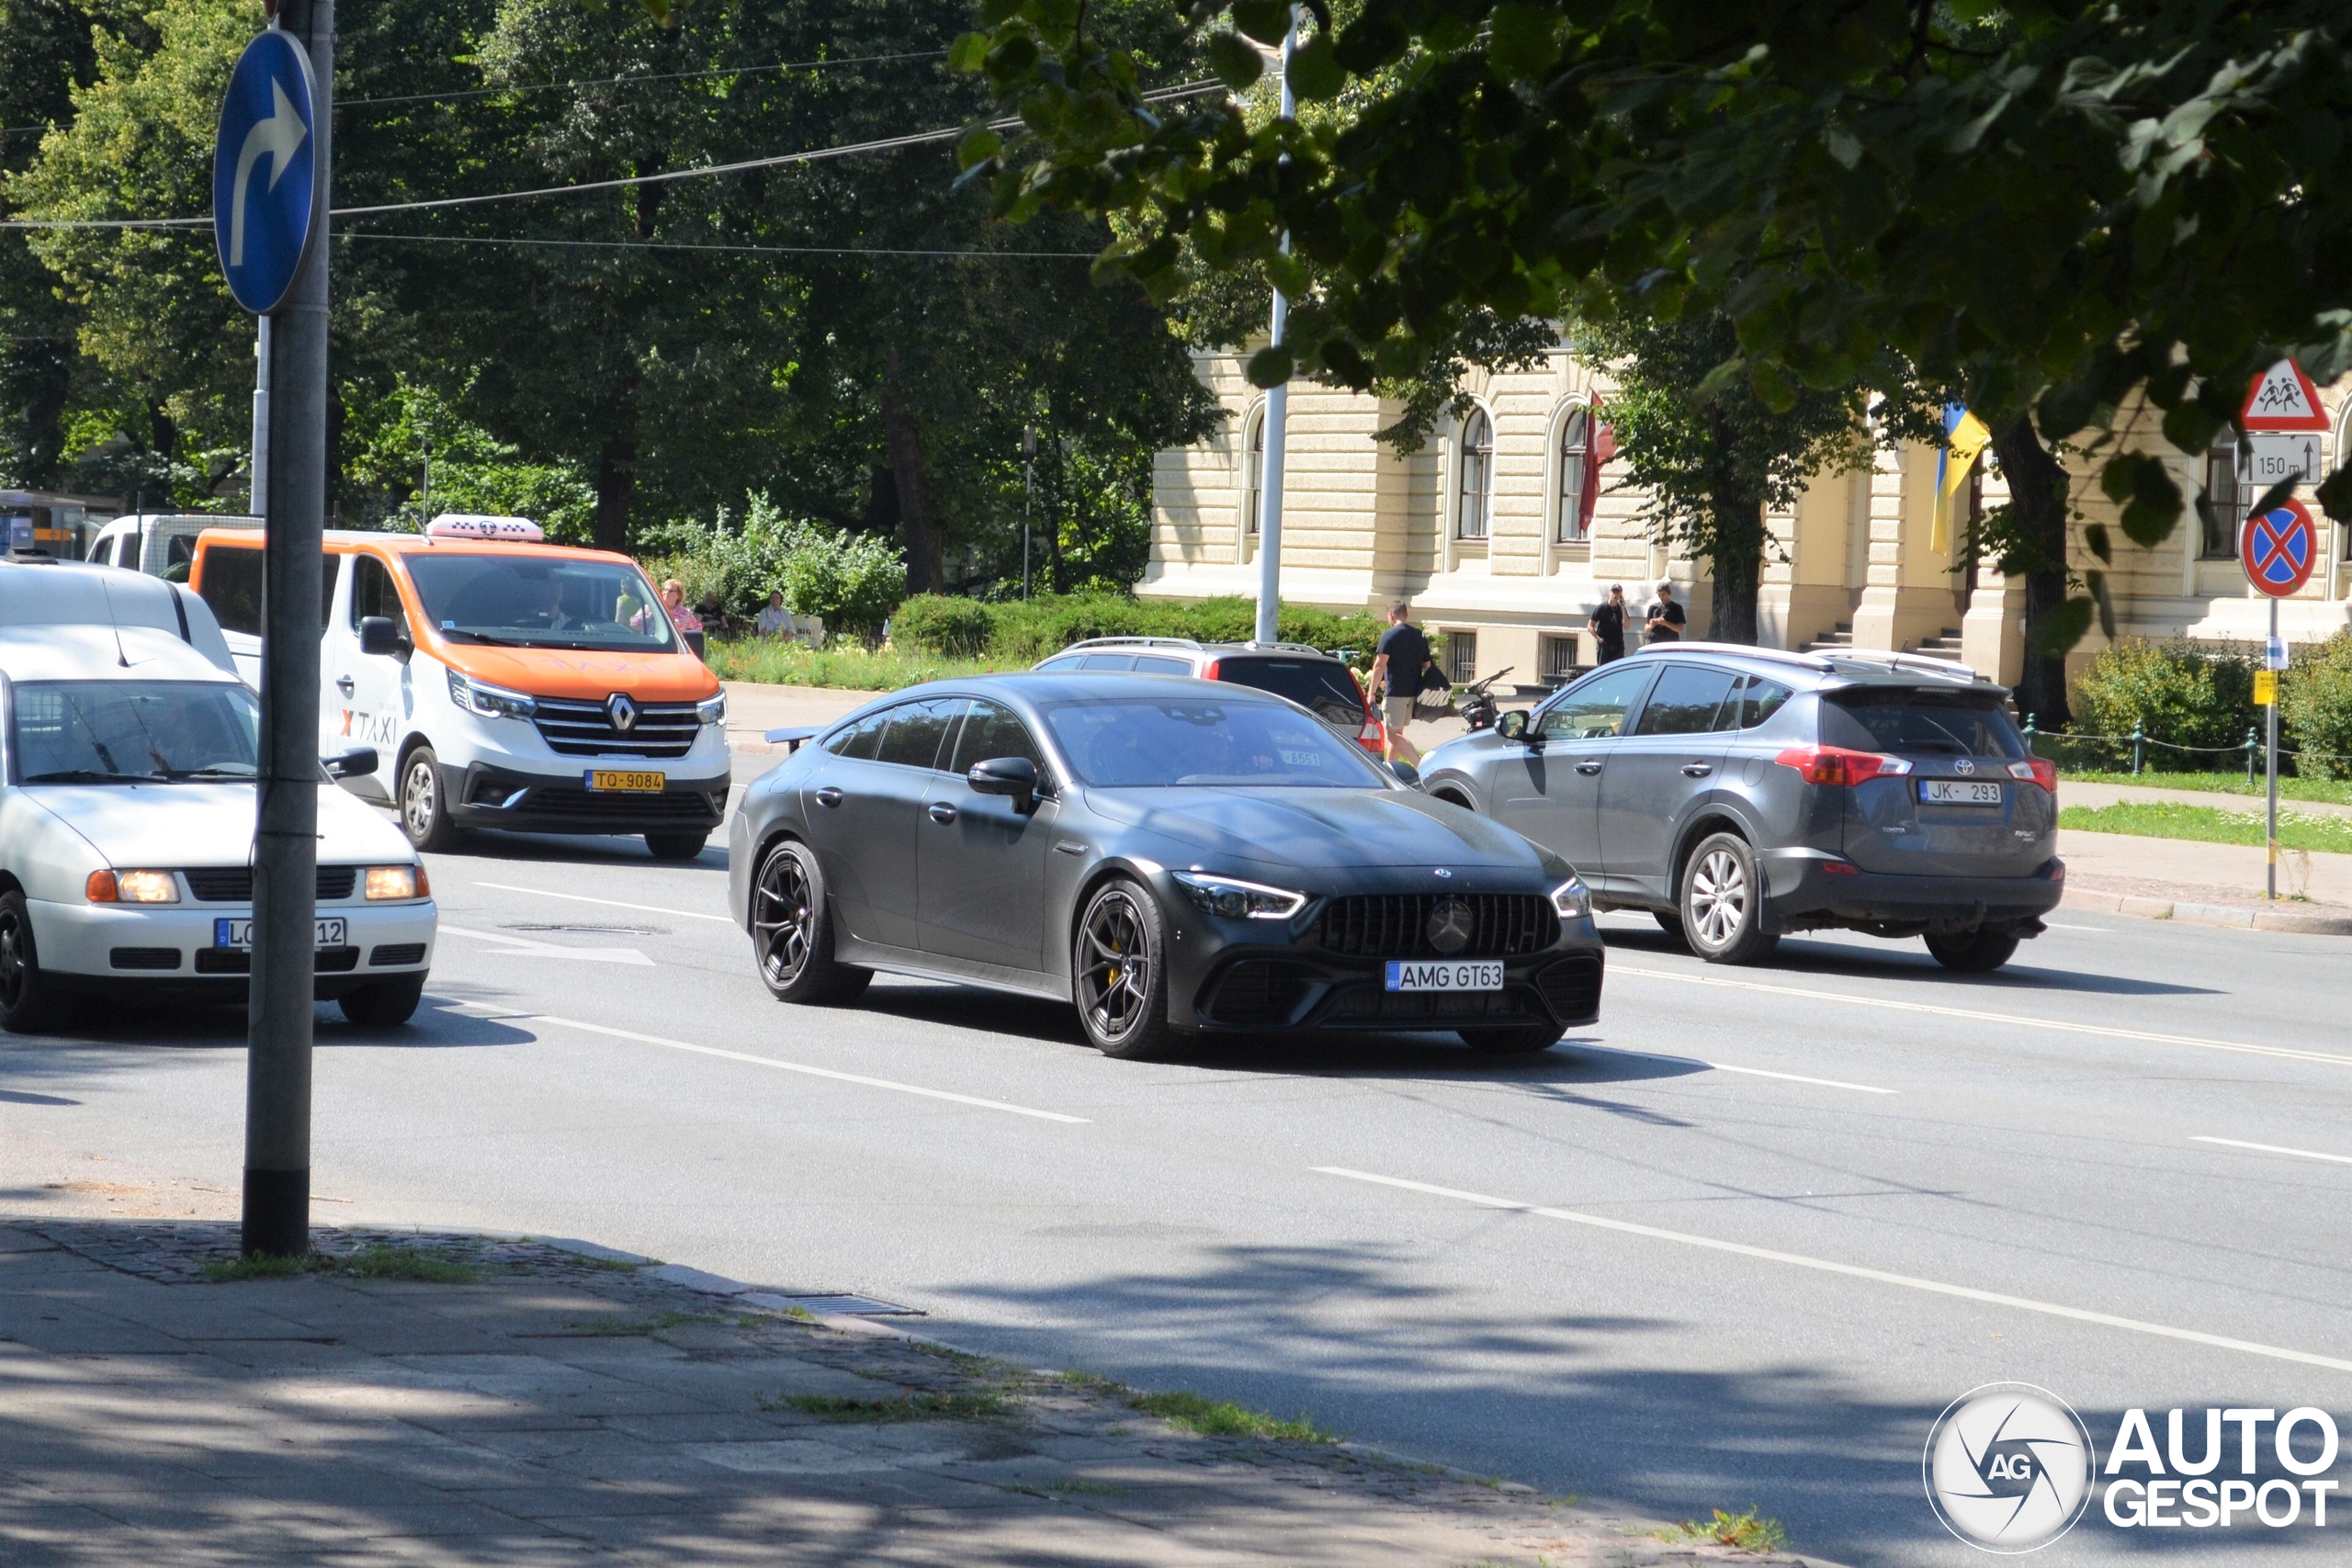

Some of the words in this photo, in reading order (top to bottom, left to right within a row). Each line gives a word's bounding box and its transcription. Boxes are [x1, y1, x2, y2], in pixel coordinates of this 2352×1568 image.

[2259, 457, 2285, 475] 150
[2289, 464, 2301, 475] m
[358, 711, 397, 746] TAXI
[596, 773, 661, 788] TQ-9084
[1972, 784, 1998, 801] 293
[1387, 979, 1399, 987] EST
[1400, 965, 1450, 987] AMG
[1456, 964, 1501, 987] GT63
